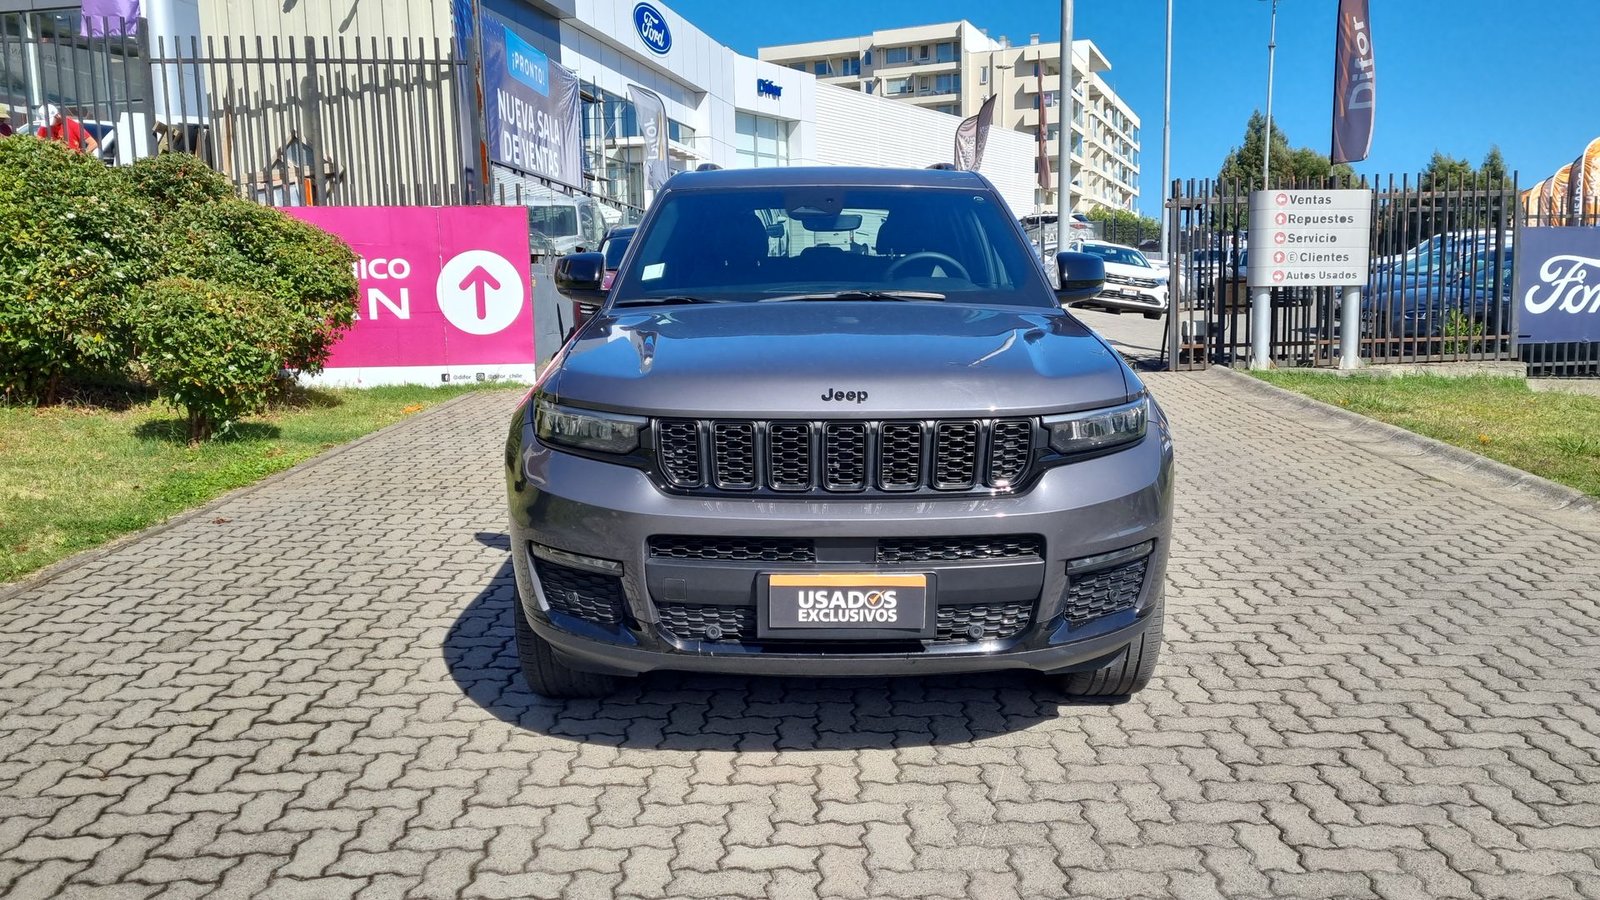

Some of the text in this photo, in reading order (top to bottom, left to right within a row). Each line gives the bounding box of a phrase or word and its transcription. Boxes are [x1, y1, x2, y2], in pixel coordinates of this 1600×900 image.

[641, 11, 665, 47] Ford
[511, 53, 545, 86] ¡PRONTO!
[1349, 16, 1373, 110] Difor
[497, 88, 561, 146] NUEVA SALA
[503, 130, 560, 177] DE VENTAS
[1289, 195, 1332, 204] Ventas
[1288, 214, 1354, 225] Repuestos
[1287, 233, 1337, 243] Servicio
[1300, 252, 1349, 262] Clientes
[1286, 270, 1358, 280] Autos Usados
[821, 388, 868, 404] Jeep
[798, 590, 898, 609] USADOS
[798, 609, 898, 622] EXCLUSIVOS
